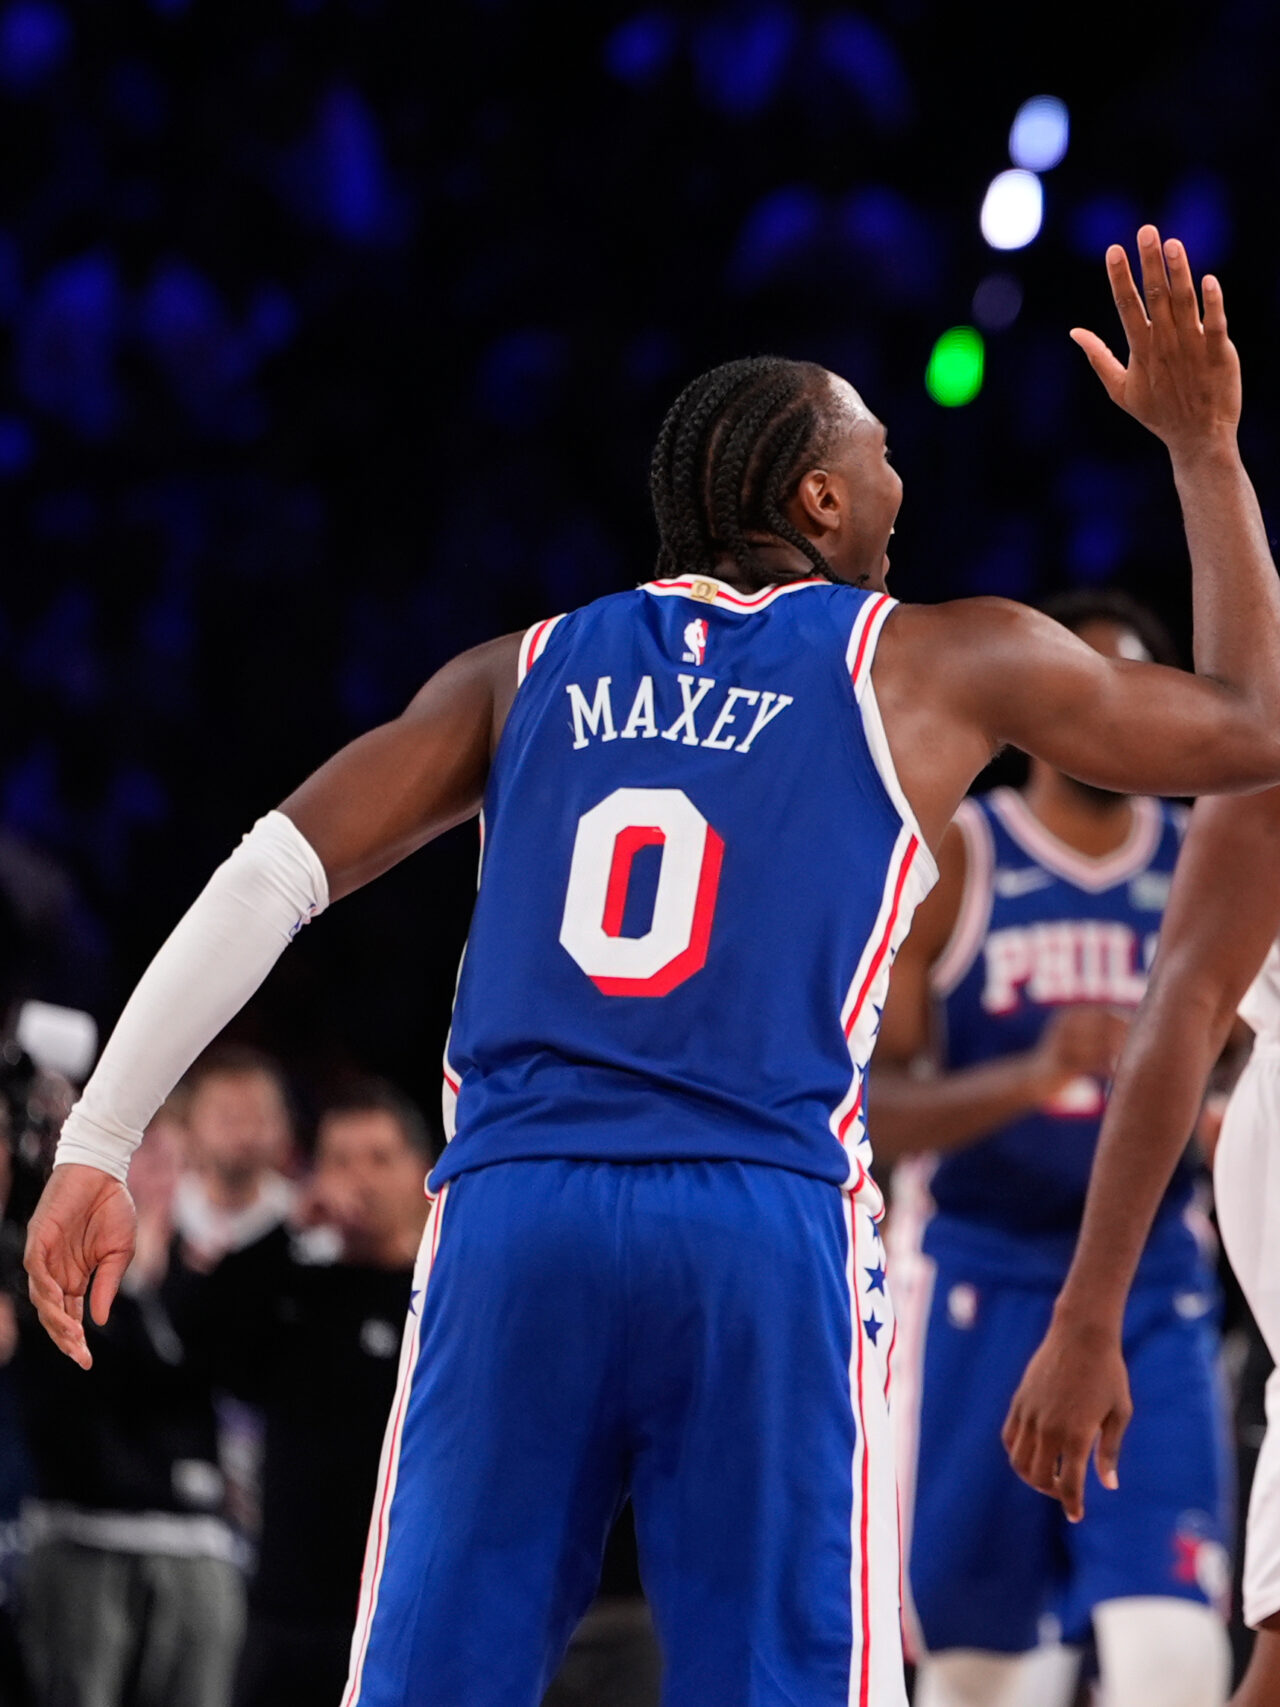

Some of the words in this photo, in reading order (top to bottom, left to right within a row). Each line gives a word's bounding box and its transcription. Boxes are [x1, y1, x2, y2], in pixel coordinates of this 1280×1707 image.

[566, 674, 793, 753] MAXEY
[559, 787, 725, 997] 0
[980, 918, 1160, 1015] PHIL
